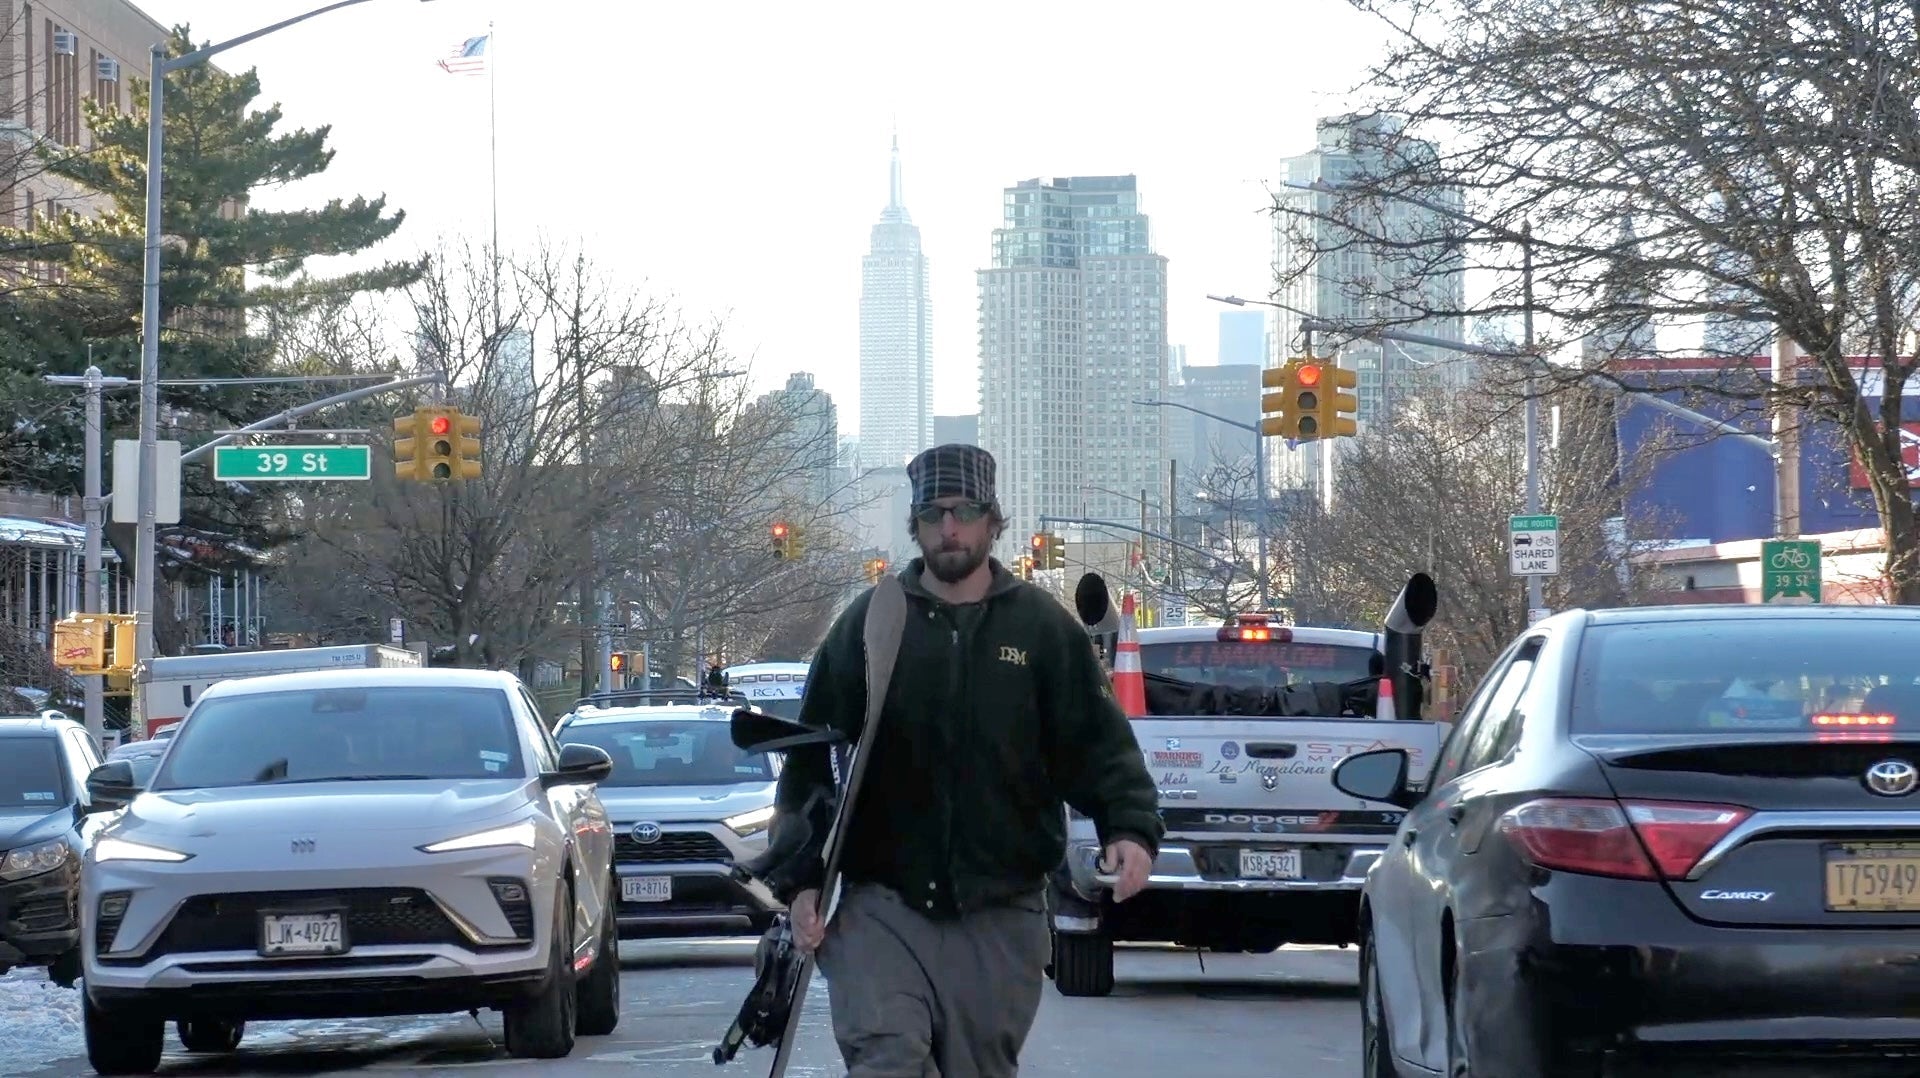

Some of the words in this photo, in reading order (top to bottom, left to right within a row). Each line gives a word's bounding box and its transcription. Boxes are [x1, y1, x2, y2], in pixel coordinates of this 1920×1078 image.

[257, 453, 288, 473] 39
[302, 453, 328, 473] St
[1531, 520, 1554, 528] ROUTE
[1514, 548, 1555, 559] SHARED
[1521, 560, 1549, 571] LANE
[1776, 575, 1790, 587] 39
[1166, 607, 1183, 618] 25
[753, 688, 785, 697] RCA
[1160, 772, 1189, 786] Mets
[1204, 814, 1320, 825] DODGE
[1700, 889, 1775, 901] CAMRY
